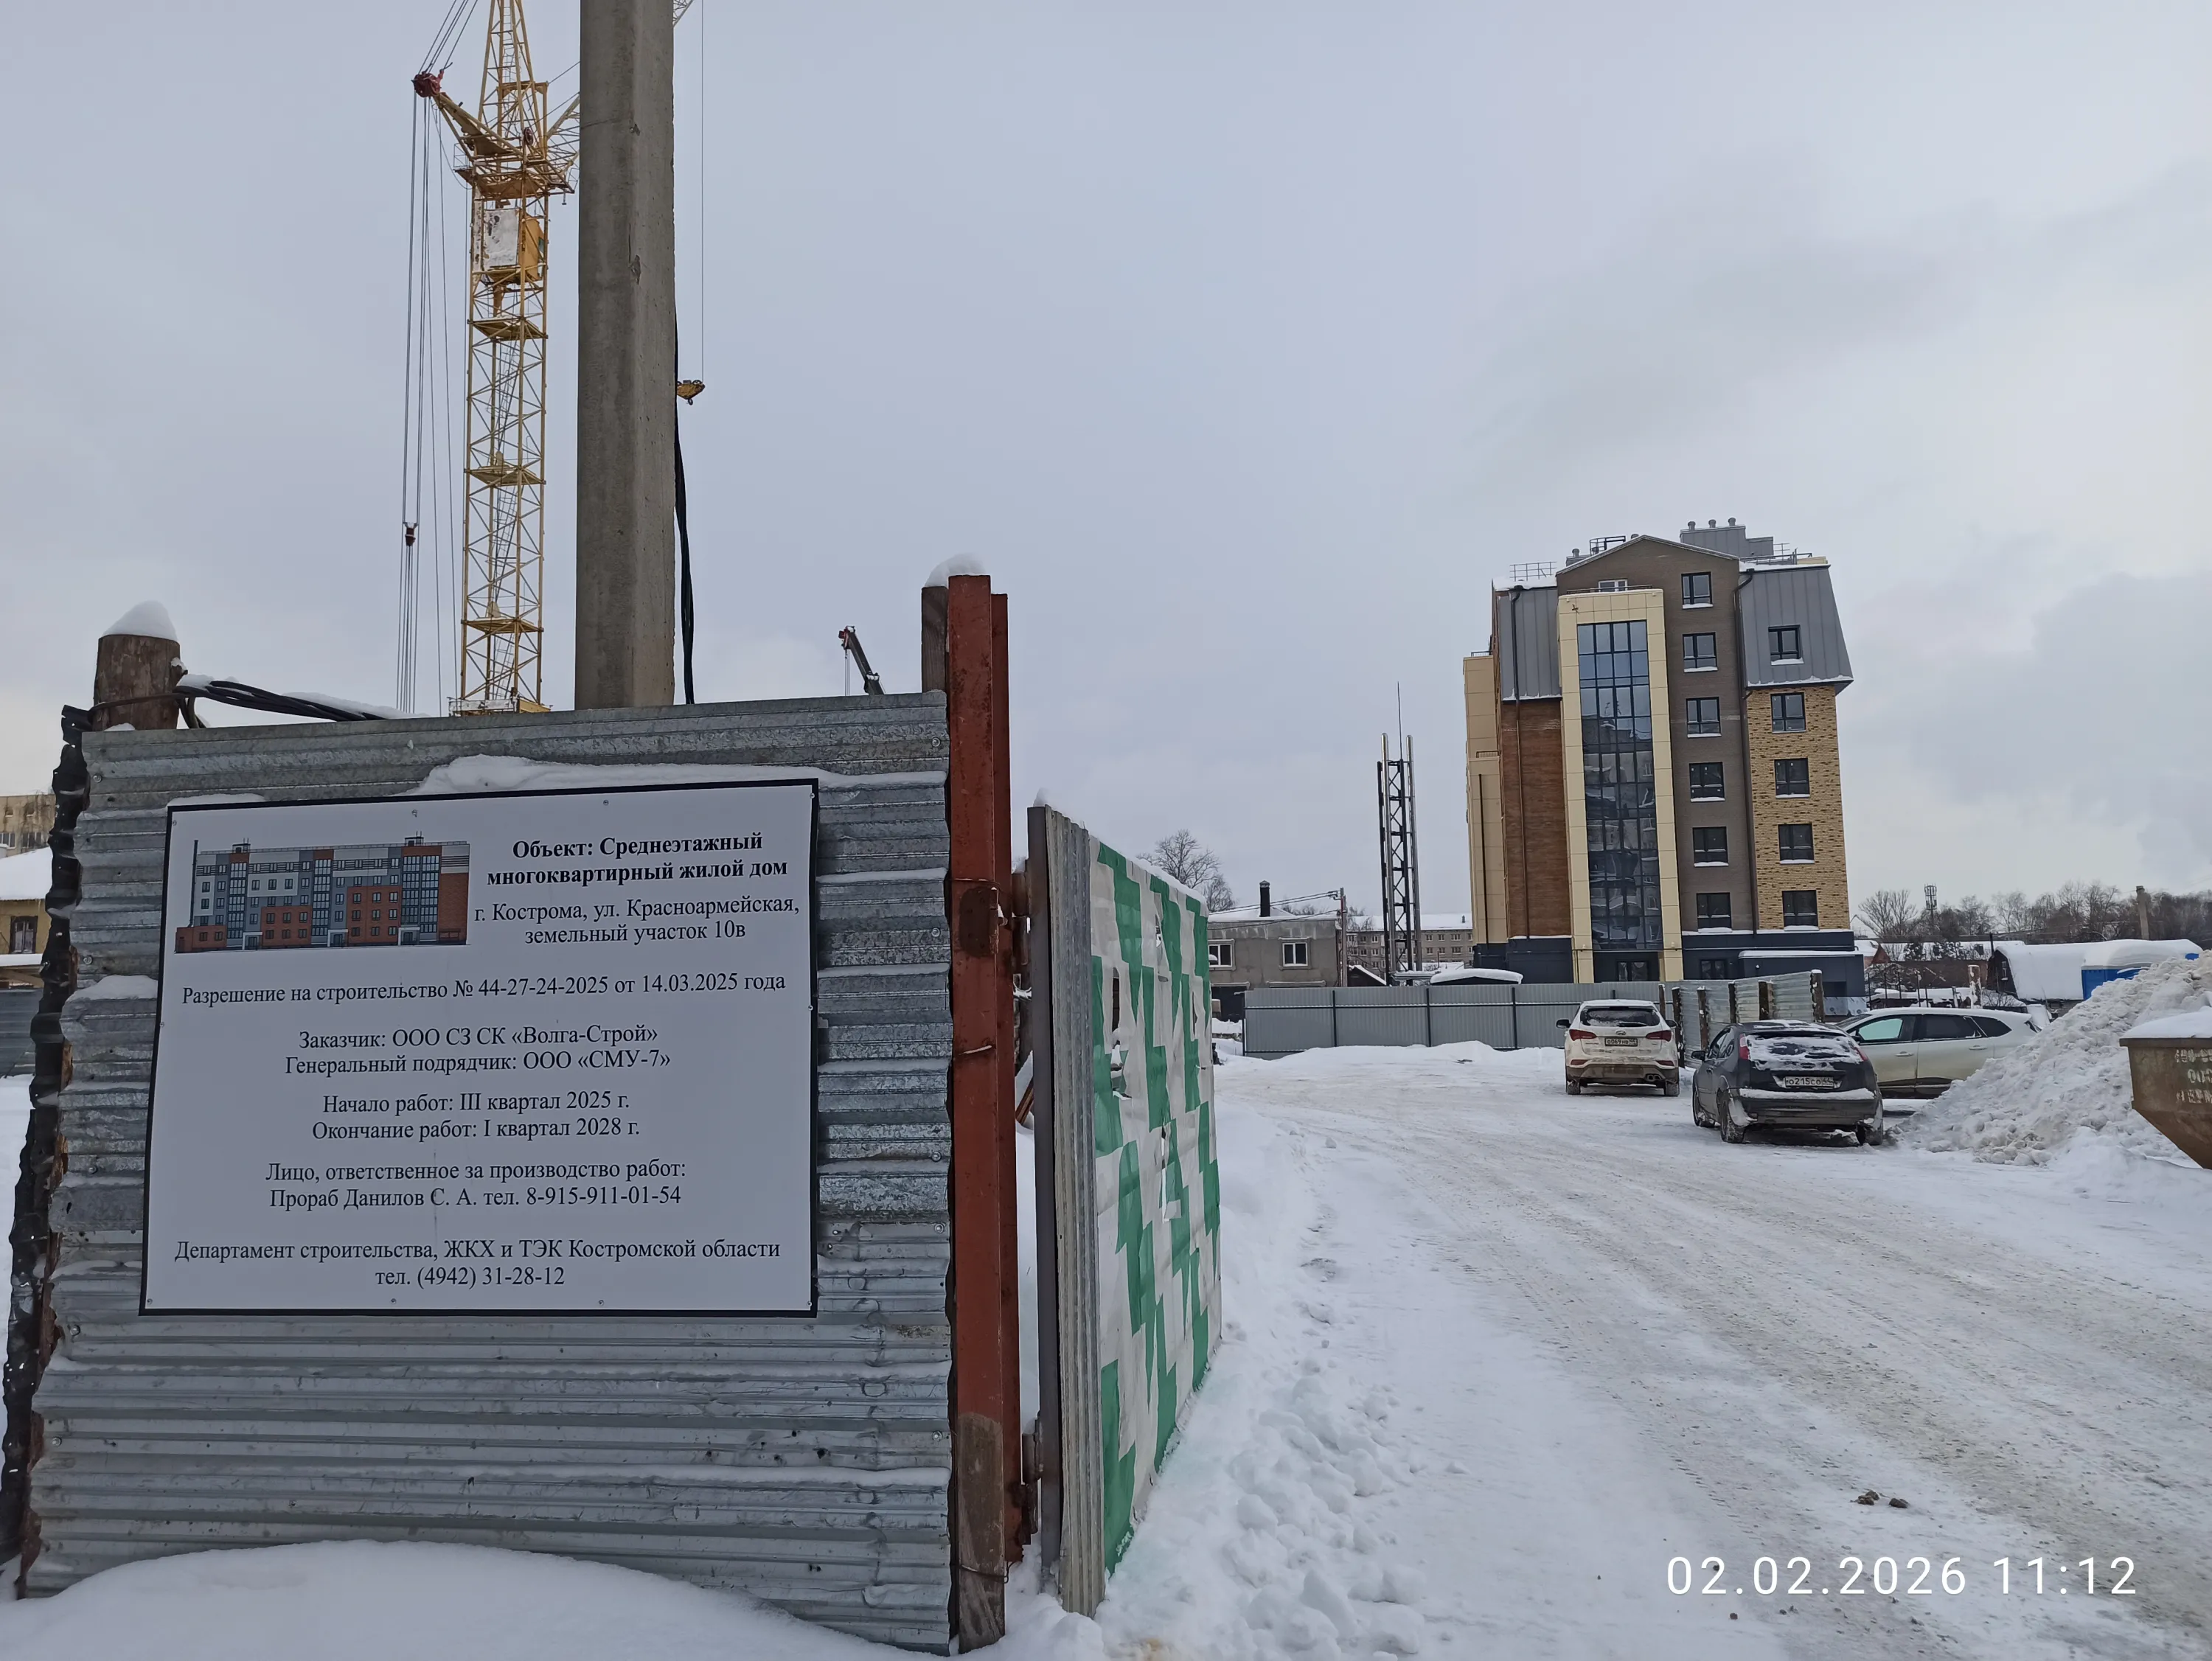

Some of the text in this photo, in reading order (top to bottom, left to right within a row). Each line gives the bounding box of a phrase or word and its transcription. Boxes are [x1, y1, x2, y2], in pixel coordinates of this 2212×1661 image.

[512, 832, 763, 860] Объект: Среднеэтажный
[487, 858, 788, 888] многоквартирный жилой дом
[474, 894, 799, 924] г. Кострома, ул. Красноармейская,
[524, 919, 746, 946] земельный участок 10в
[181, 972, 786, 1009] Разрешение на строительство № 44-27-24-2025 от 14.03.2025 года
[299, 1023, 658, 1049] Заказчик: ООО СЗ СК «Волга-Строй»
[285, 1049, 671, 1079] Генеральный подрядчик: ООО «СМУ-7»
[322, 1090, 630, 1117] Начало работ: III квартал 2025 г.
[312, 1117, 640, 1143] Окончание работ: I квартал 2028 г.
[265, 1157, 686, 1184] Лицо, ответственное за производство работ:
[269, 1185, 681, 1212] Прораб Данилов С. А. тел. 8-915-911-01-54
[174, 1238, 781, 1264] Департамент строительства, ЖКХ и ТЭК Костромской области
[375, 1267, 565, 1290] тел. (4942) 31-28-12
